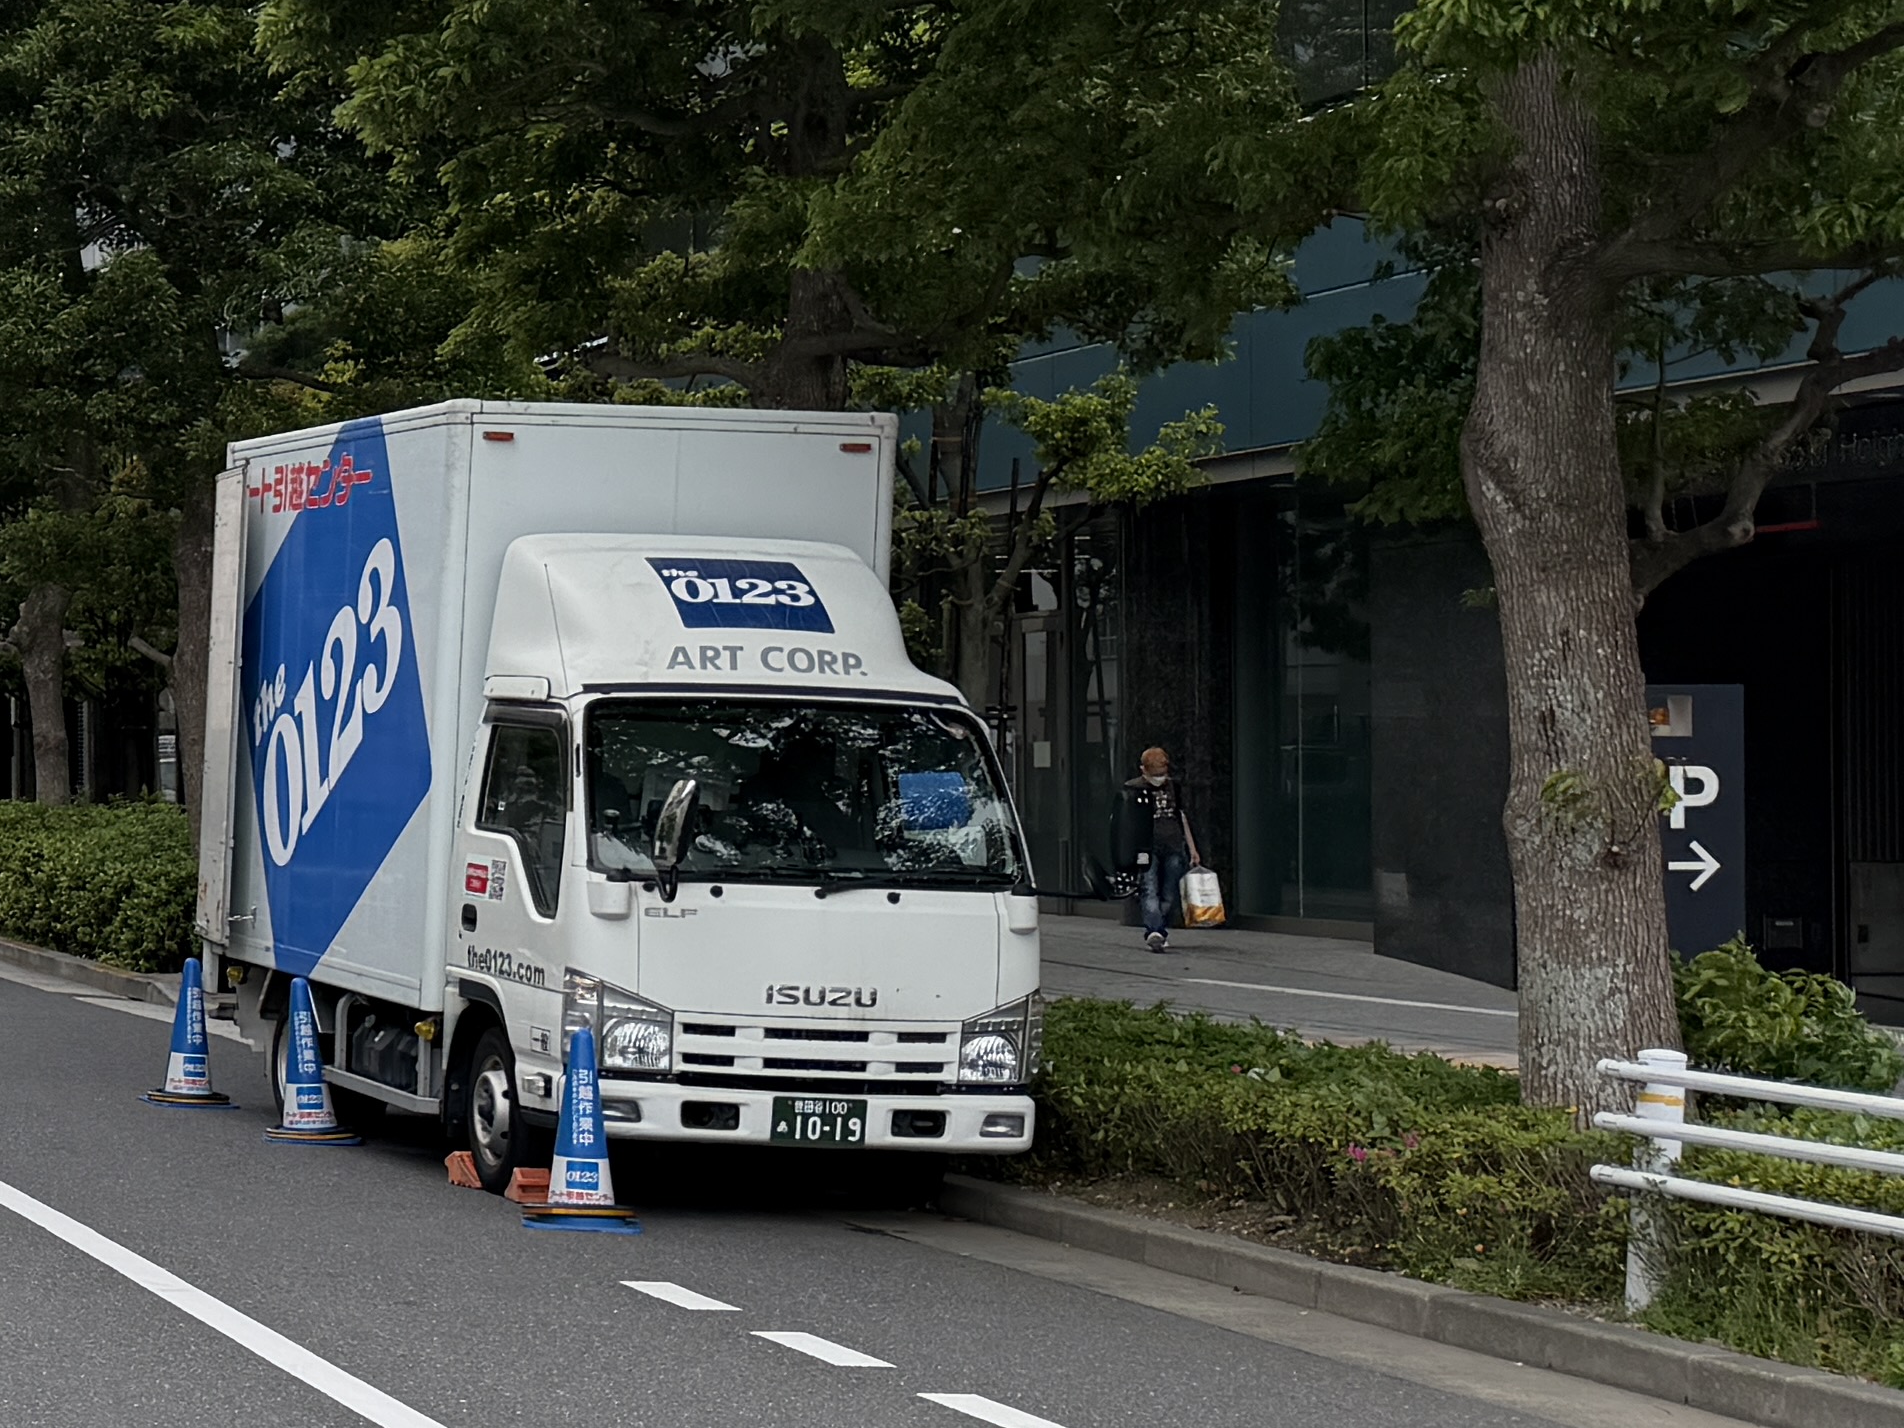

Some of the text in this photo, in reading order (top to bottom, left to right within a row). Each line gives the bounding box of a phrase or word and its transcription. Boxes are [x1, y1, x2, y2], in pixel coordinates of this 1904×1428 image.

[248, 452, 374, 514] ート引越センター
[661, 568, 699, 578] the
[670, 577, 816, 607] 0123
[666, 645, 869, 676] ART CORP.
[253, 663, 286, 747] the
[263, 538, 403, 867] 0123
[1668, 765, 1720, 829] P
[644, 907, 698, 919] ELF
[467, 944, 546, 987] the0123.com
[765, 984, 878, 1008] ISUZU
[578, 1068, 594, 1146] 引越作業中
[794, 1115, 862, 1142] 10-19
[566, 1170, 599, 1183] 0123
